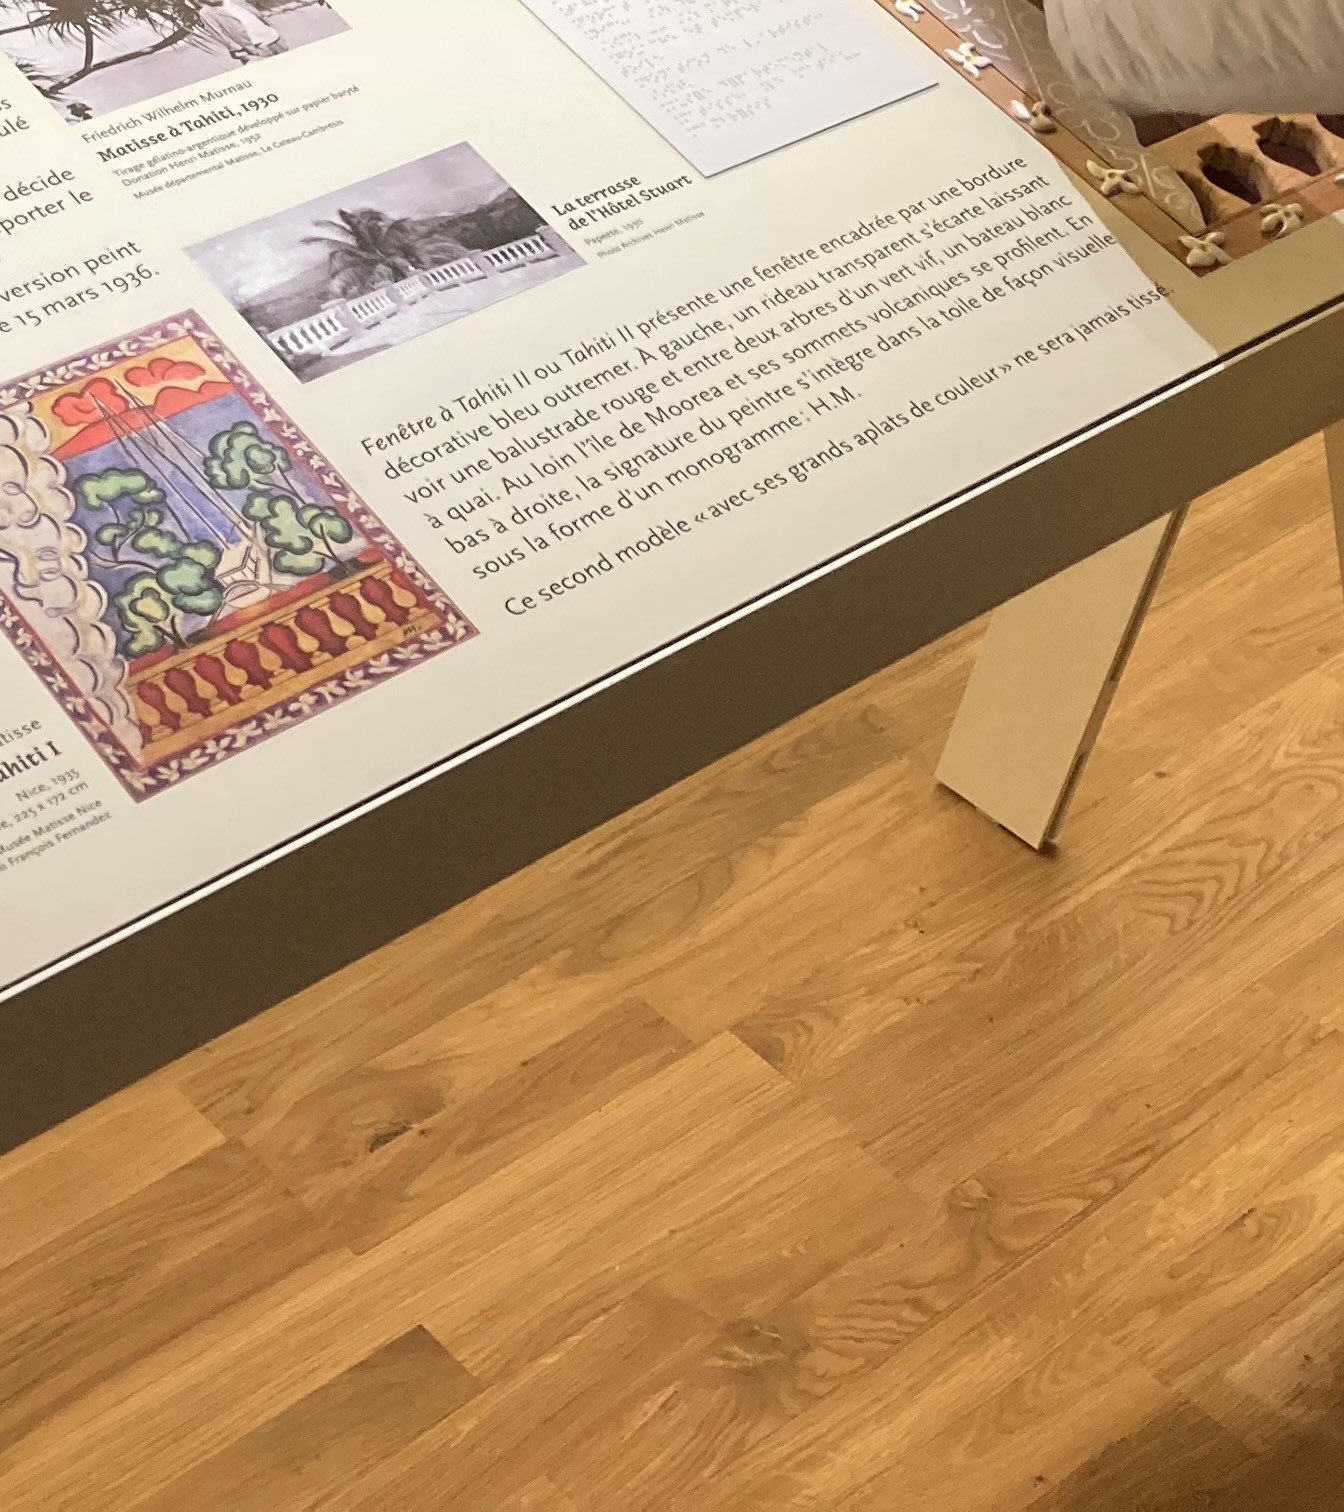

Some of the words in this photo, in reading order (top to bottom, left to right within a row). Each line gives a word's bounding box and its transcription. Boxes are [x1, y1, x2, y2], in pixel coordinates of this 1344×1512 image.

[81, 117, 143, 144] Friedrich
[140, 99, 200, 122] Wilhelm
[199, 80, 253, 103] Murnau
[95, 131, 169, 163] Matisse
[165, 124, 183, 138] à
[178, 104, 243, 132] Tahiti,
[238, 92, 279, 112] 1930
[549, 201, 578, 217] La
[573, 175, 642, 207] terrasse
[567, 216, 590, 231] de
[638, 174, 693, 202] Stuart
[12, 308, 42, 327] 15
[40, 286, 100, 317] mars
[99, 262, 160, 294] 1936.
[359, 415, 437, 456] Fenêtre
[437, 404, 455, 422] à
[451, 376, 513, 413] Tahiti
[511, 369, 531, 389] II
[533, 360, 563, 380] ou
[558, 331, 617, 366] Tahiti
[615, 323, 635, 343] II
[634, 292, 719, 339] présente
[717, 275, 756, 298] une
[751, 247, 820, 282] fenêtre
[818, 213, 898, 254] encadrée
[896, 199, 927, 224] par
[926, 185, 963, 207] une
[955, 157, 1028, 192] bordure
[471, 546, 526, 580] sous
[521, 535, 551, 553] la
[547, 503, 616, 542] forme
[806, 385, 862, 416] H.M.
[45, 739, 62, 757] I
